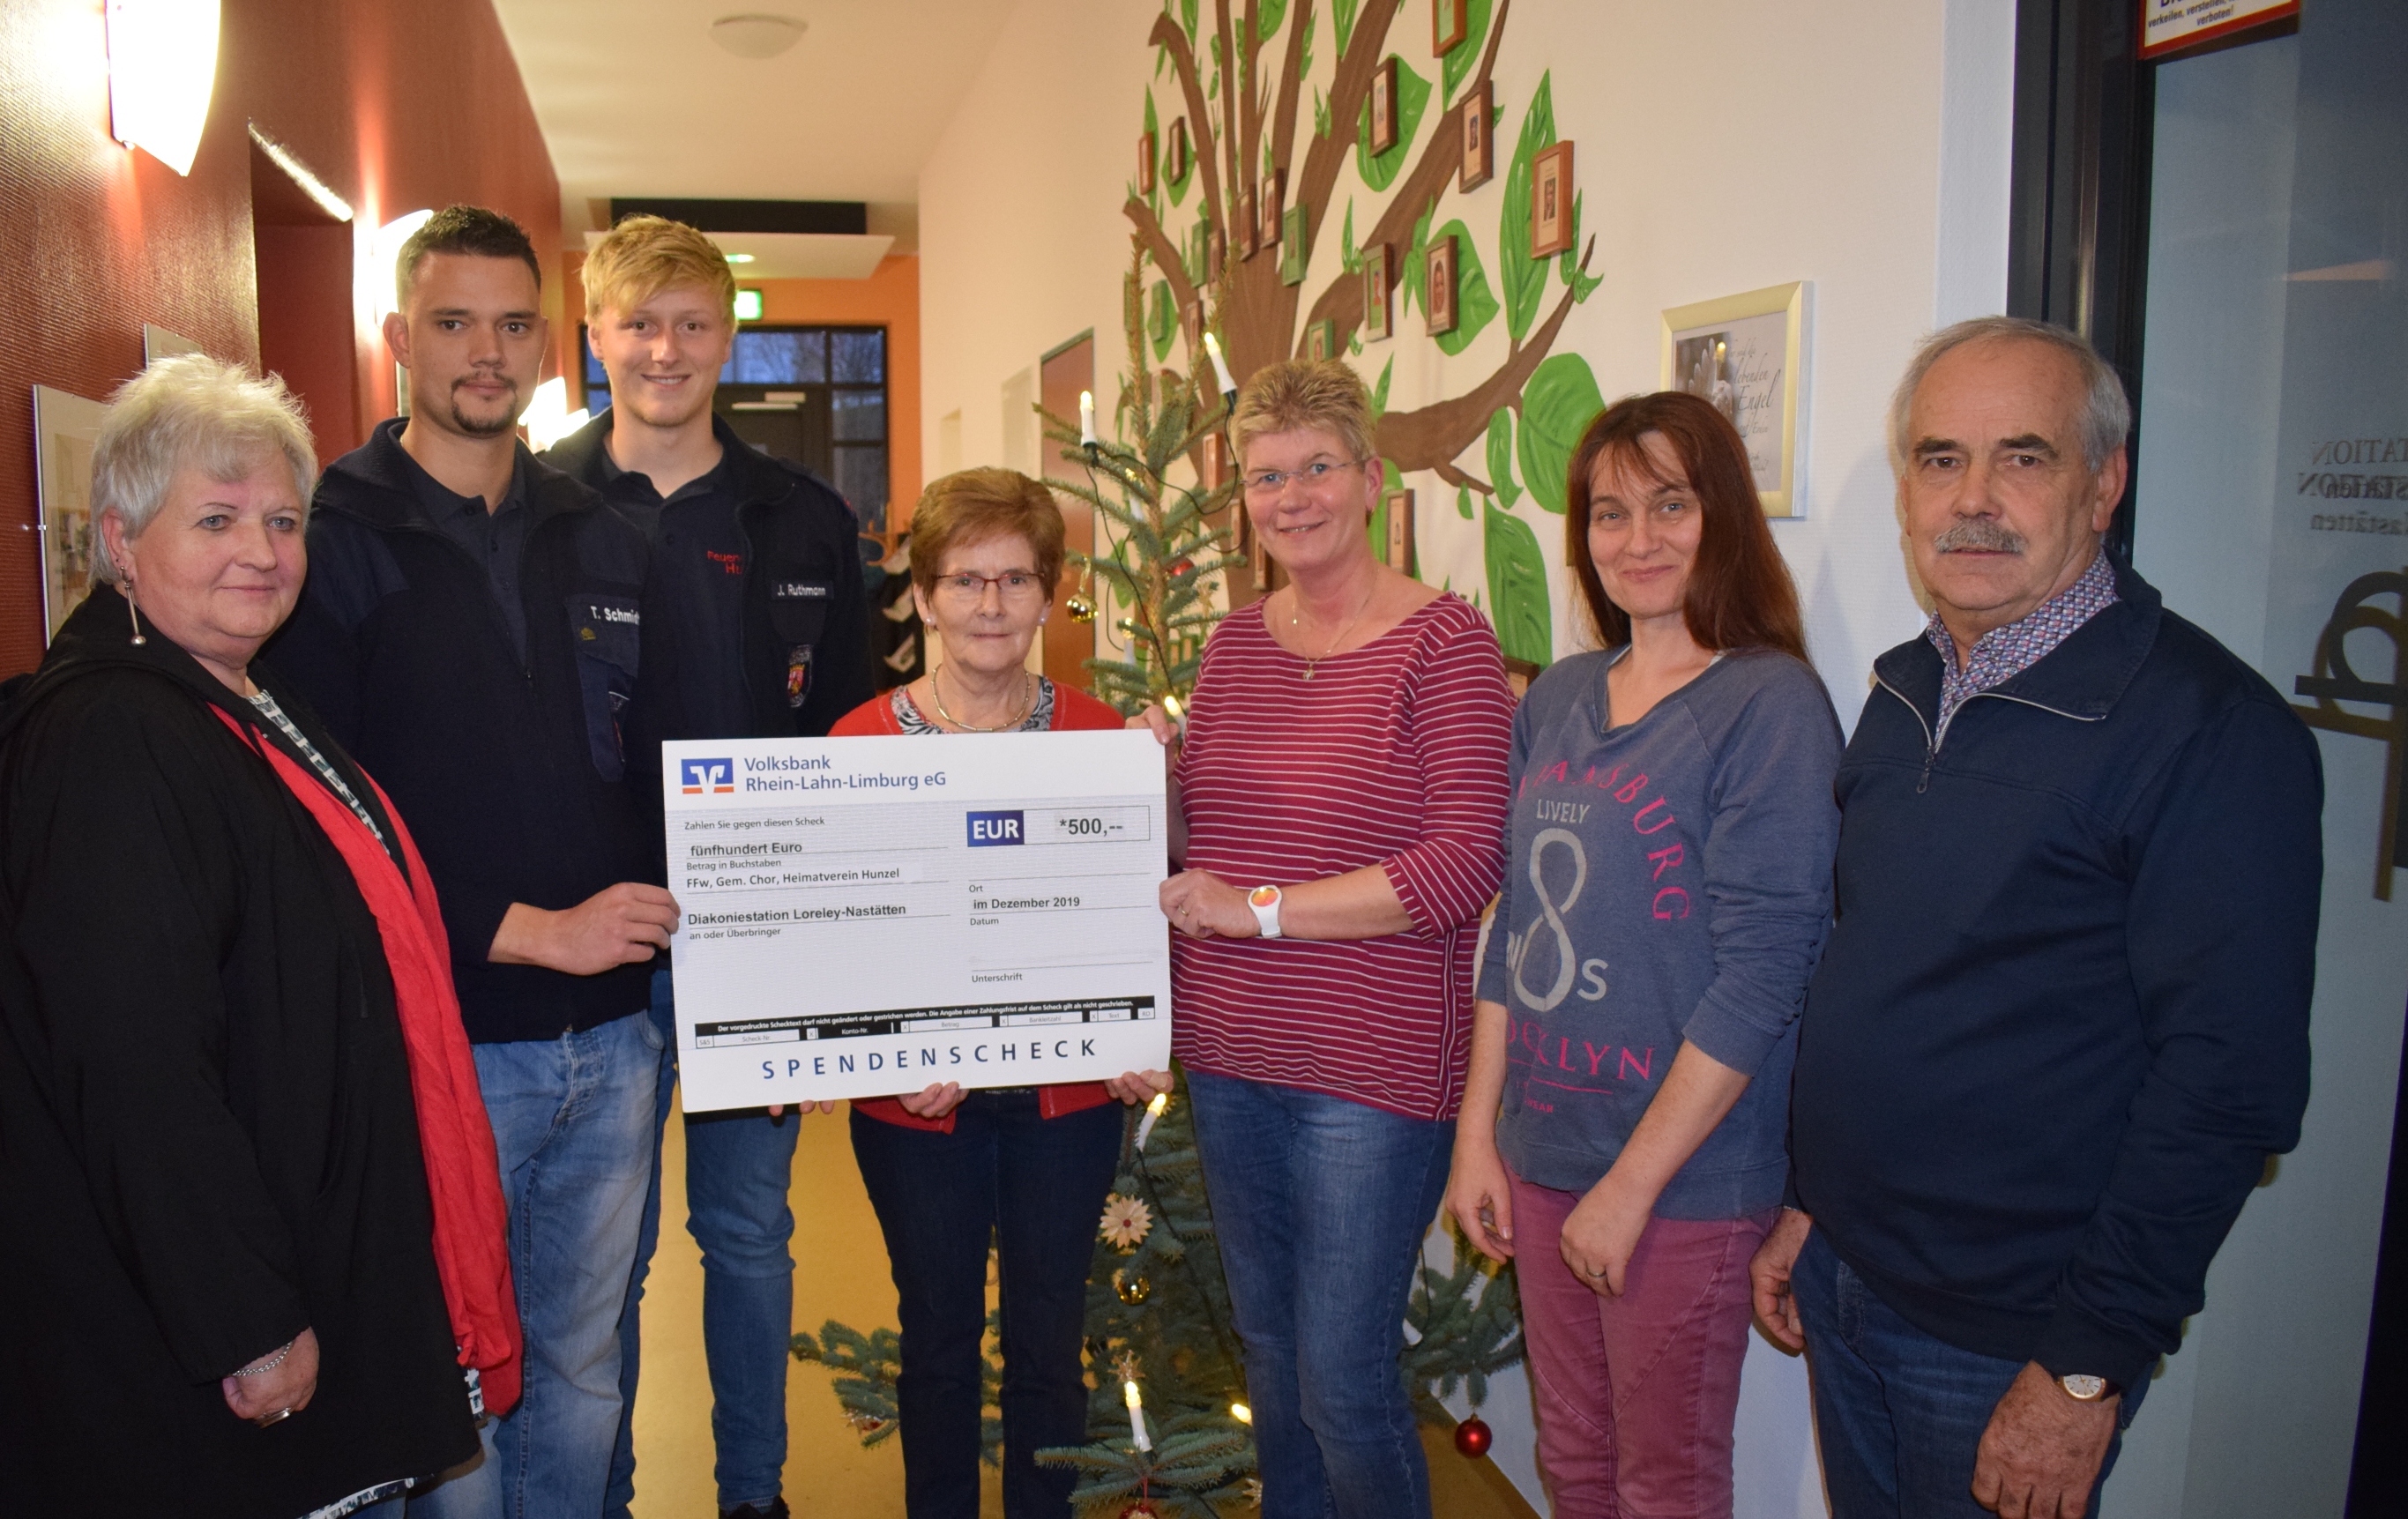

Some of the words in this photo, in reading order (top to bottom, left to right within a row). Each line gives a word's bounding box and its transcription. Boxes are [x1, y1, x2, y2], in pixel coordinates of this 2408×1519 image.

[2148, 10, 2185, 28] verkeilen,
[2196, 4, 2234, 26] verboten!
[787, 583, 826, 597] Ruthmann
[590, 605, 601, 620] T.
[743, 755, 831, 772] Volksbank
[745, 772, 920, 792] Rhein-Lahn-Limburg
[923, 771, 947, 786] eG
[1536, 799, 1591, 824] LIVELY
[684, 821, 715, 830] Zahlen
[717, 820, 731, 830] Sie
[733, 821, 762, 831] gegen
[764, 818, 793, 828] diesen
[794, 816, 825, 826] Scheck
[973, 819, 1019, 840] EUR
[690, 842, 769, 857] fünfhundert
[772, 842, 803, 854] Euro
[686, 861, 716, 872] Betrag
[719, 860, 727, 870] in
[729, 859, 782, 869] Buchstaben
[686, 877, 713, 889] FFw,
[715, 876, 747, 888] Gem.
[749, 874, 779, 886] Chor,
[782, 869, 859, 884] Heimatverein
[861, 868, 900, 880] Hunzel
[968, 884, 984, 894] Ort
[973, 898, 988, 910] im
[991, 897, 1050, 910] Dezember
[1053, 897, 1081, 908] 2019
[688, 909, 789, 926] Diakoniestation
[793, 904, 907, 920] Loreley-Nastätten
[969, 917, 1000, 927] Datum
[689, 931, 702, 941] an
[703, 929, 726, 940] oder
[727, 927, 782, 939] Überbringer
[971, 972, 1023, 983] Unterschrift
[718, 1024, 728, 1033] Der
[729, 1022, 770, 1033] vorgedruckte
[770, 1019, 801, 1029] Schecktext
[801, 1018, 816, 1027] darf
[816, 1017, 831, 1026] nicht
[831, 1015, 859, 1026] geändert
[859, 1014, 873, 1023] oder
[873, 1012, 904, 1024] gestrichen
[904, 1010, 928, 1020] werden.
[939, 1008, 963, 1018] Angabe
[963, 1007, 978, 1016] einer
[979, 1004, 1017, 1016] Zahlungsfrist
[1017, 1003, 1028, 1013] auf
[1028, 1003, 1042, 1012] dem
[1042, 1002, 1062, 1012] Scheck
[1062, 1001, 1073, 1012] gilt
[1073, 1001, 1083, 1010] als
[1082, 1000, 1098, 1009] nicht
[1098, 999, 1134, 1010] geschrieben.
[841, 1026, 869, 1036] Konto-Nr.
[941, 1020, 960, 1029] Betrag
[1029, 1015, 1062, 1024] Bankleitzahl
